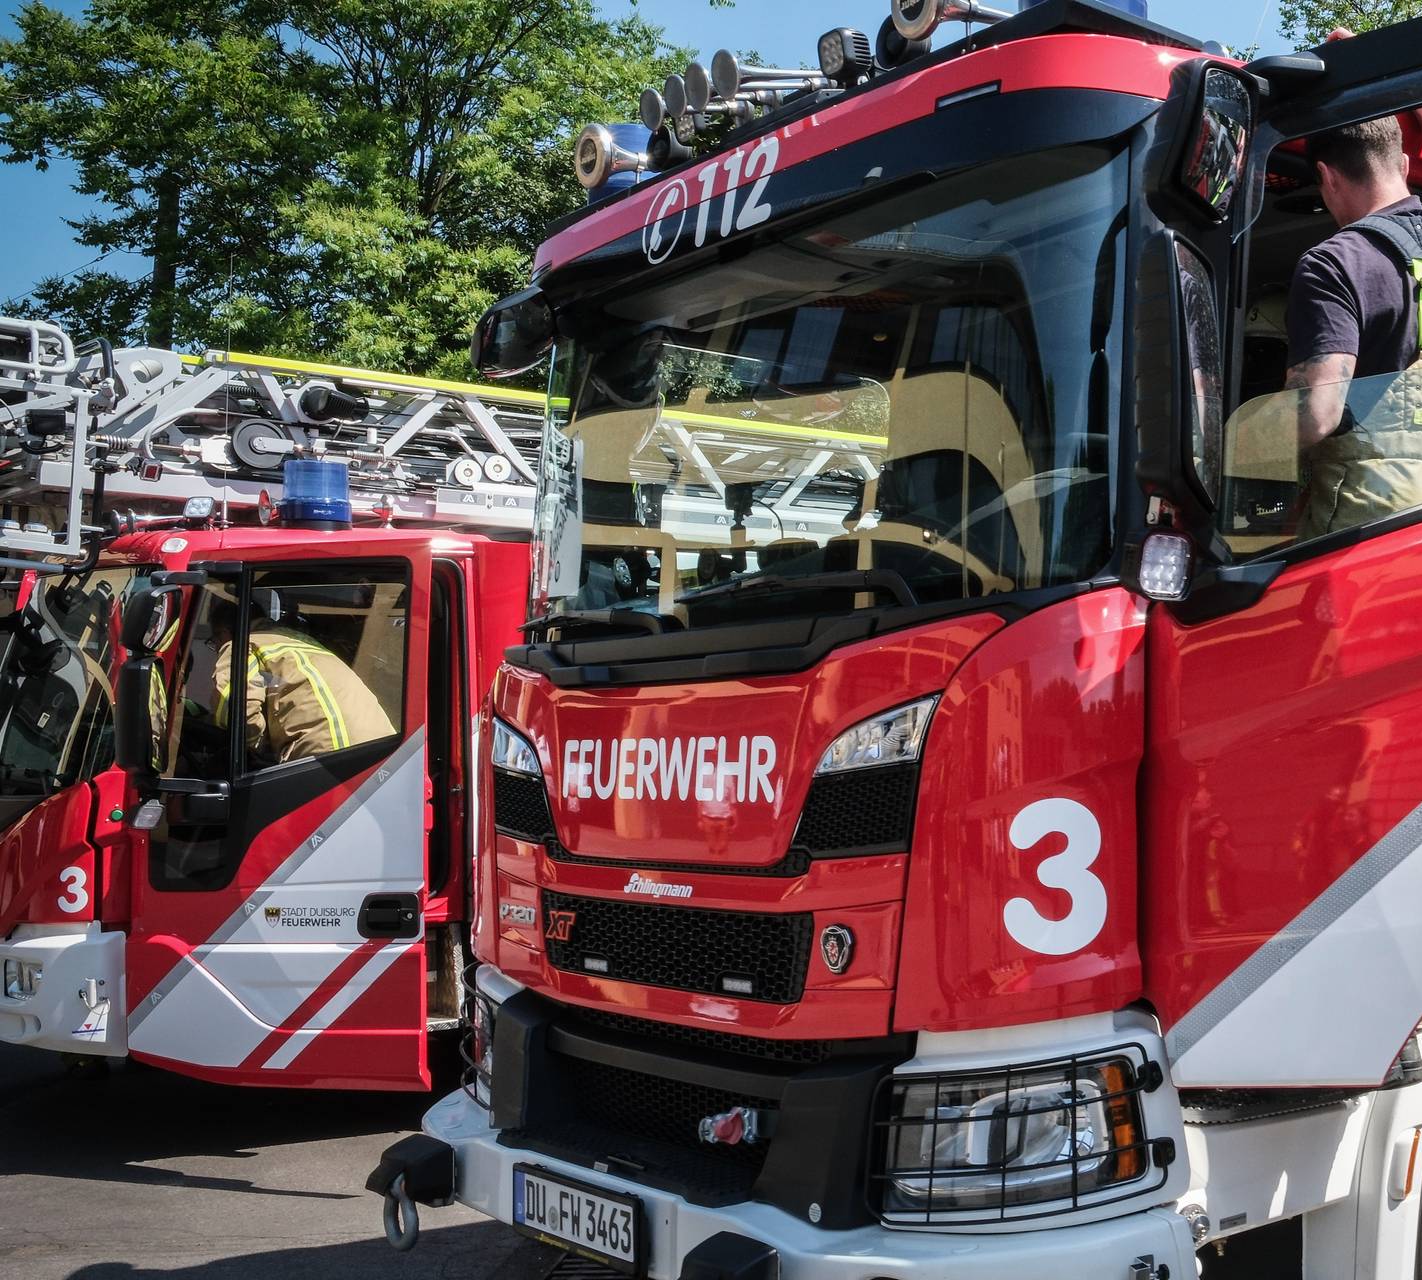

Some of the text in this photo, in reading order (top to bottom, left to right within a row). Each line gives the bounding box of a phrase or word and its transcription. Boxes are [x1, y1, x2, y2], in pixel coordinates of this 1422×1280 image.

[694, 136, 779, 248] 112
[562, 735, 776, 803] FEUERWEHR
[57, 866, 89, 913] 3
[623, 872, 693, 898] Schlingmann
[1003, 797, 1108, 956] 3
[281, 907, 355, 917] STADT DUISBURG
[281, 918, 341, 927] FEUERWEHR
[545, 910, 577, 941] XT
[525, 1179, 547, 1226] DU
[559, 1190, 581, 1238] FW
[585, 1198, 632, 1254] 3463
